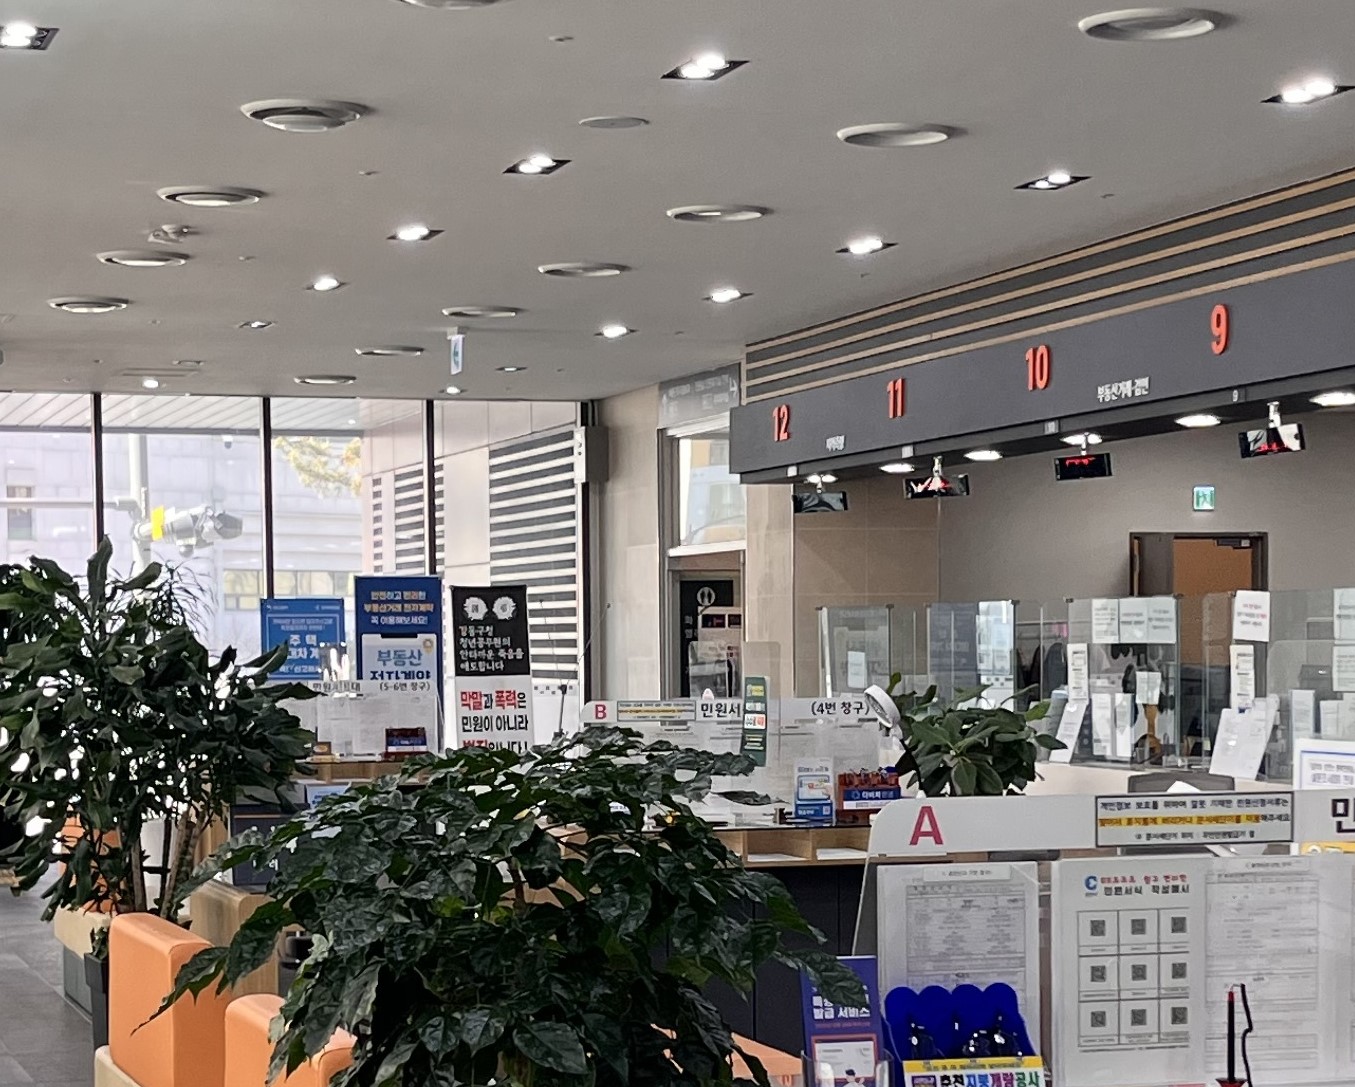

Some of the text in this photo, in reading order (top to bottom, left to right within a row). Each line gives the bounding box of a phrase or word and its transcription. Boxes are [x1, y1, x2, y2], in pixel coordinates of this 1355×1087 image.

[1209, 303, 1231, 355] 9
[1025, 343, 1049, 392] 10
[886, 377, 905, 419] 11
[1231, 389, 1239, 402] 9
[772, 404, 791, 442] 12
[376, 649, 423, 666] 부동산
[459, 661, 505, 672] 애도합니다
[460, 689, 527, 711] 막말과 폭력은
[700, 702, 742, 718] 민원서
[810, 701, 837, 716] (4번
[840, 700, 871, 716] 창구)
[594, 704, 607, 720] B
[461, 713, 529, 733] 민원이 아니라
[908, 805, 945, 846] A
[837, 1006, 871, 1018] 서비스
